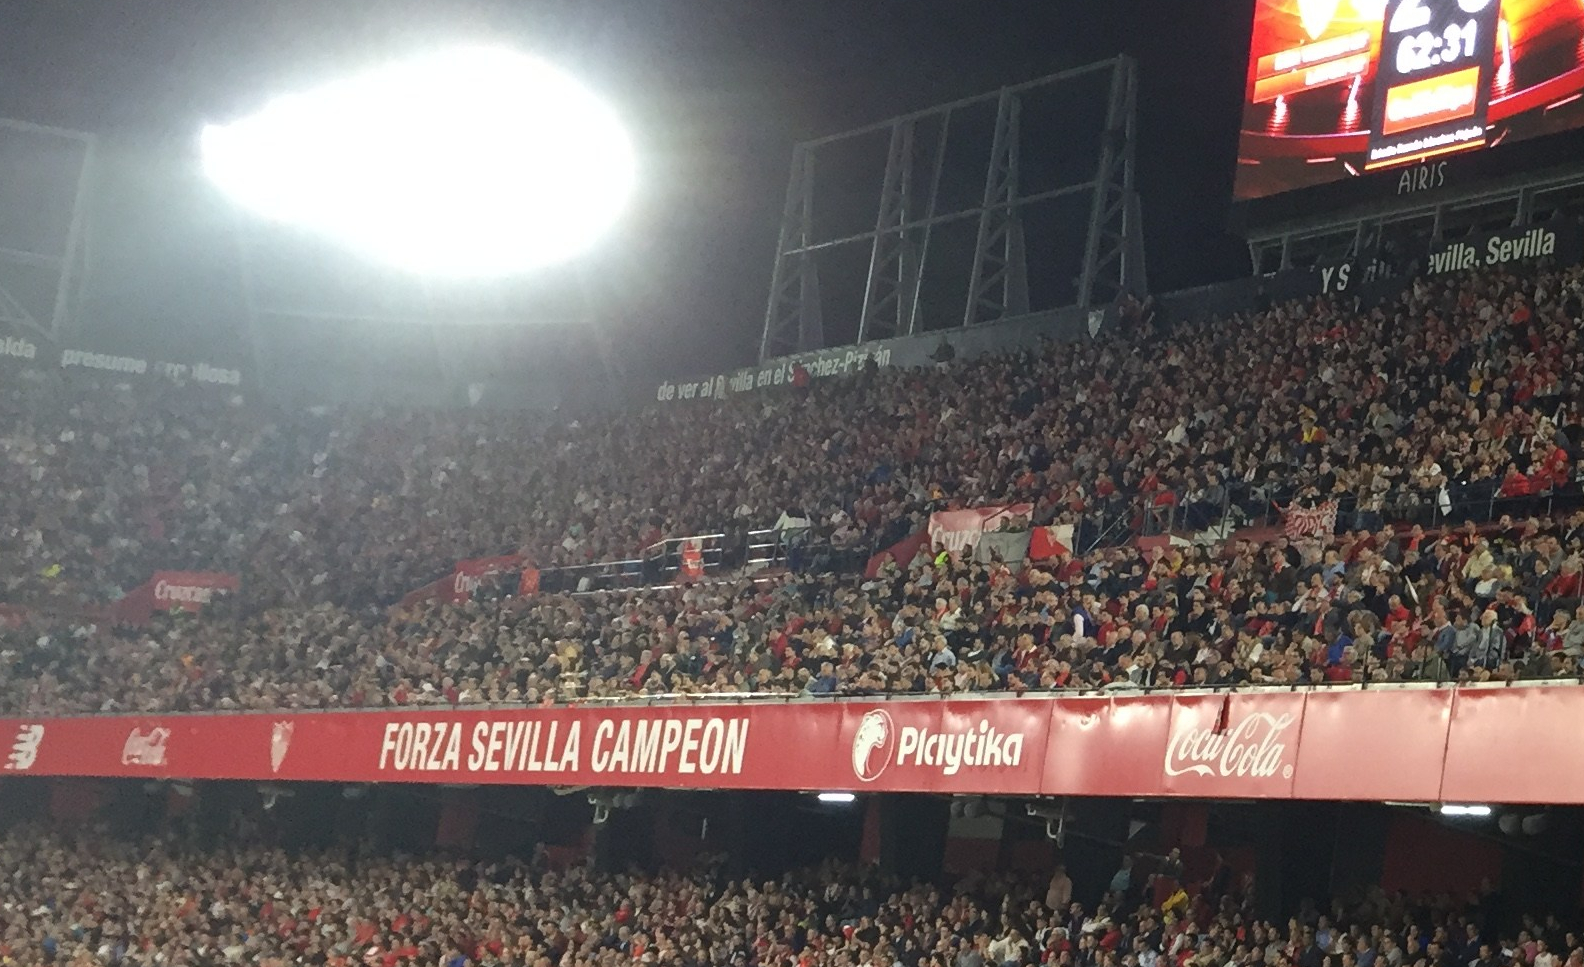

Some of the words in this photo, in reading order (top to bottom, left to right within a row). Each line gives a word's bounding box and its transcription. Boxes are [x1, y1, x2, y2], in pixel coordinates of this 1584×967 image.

[1398, 161, 1447, 194] AIRIS
[1486, 228, 1556, 265] Sevilla
[757, 369, 773, 388] en
[774, 364, 786, 385] el
[379, 722, 462, 770] FORZA
[468, 720, 581, 772] SEVILLA
[591, 718, 749, 775] CAMPEON
[897, 719, 1024, 775] Playtika
